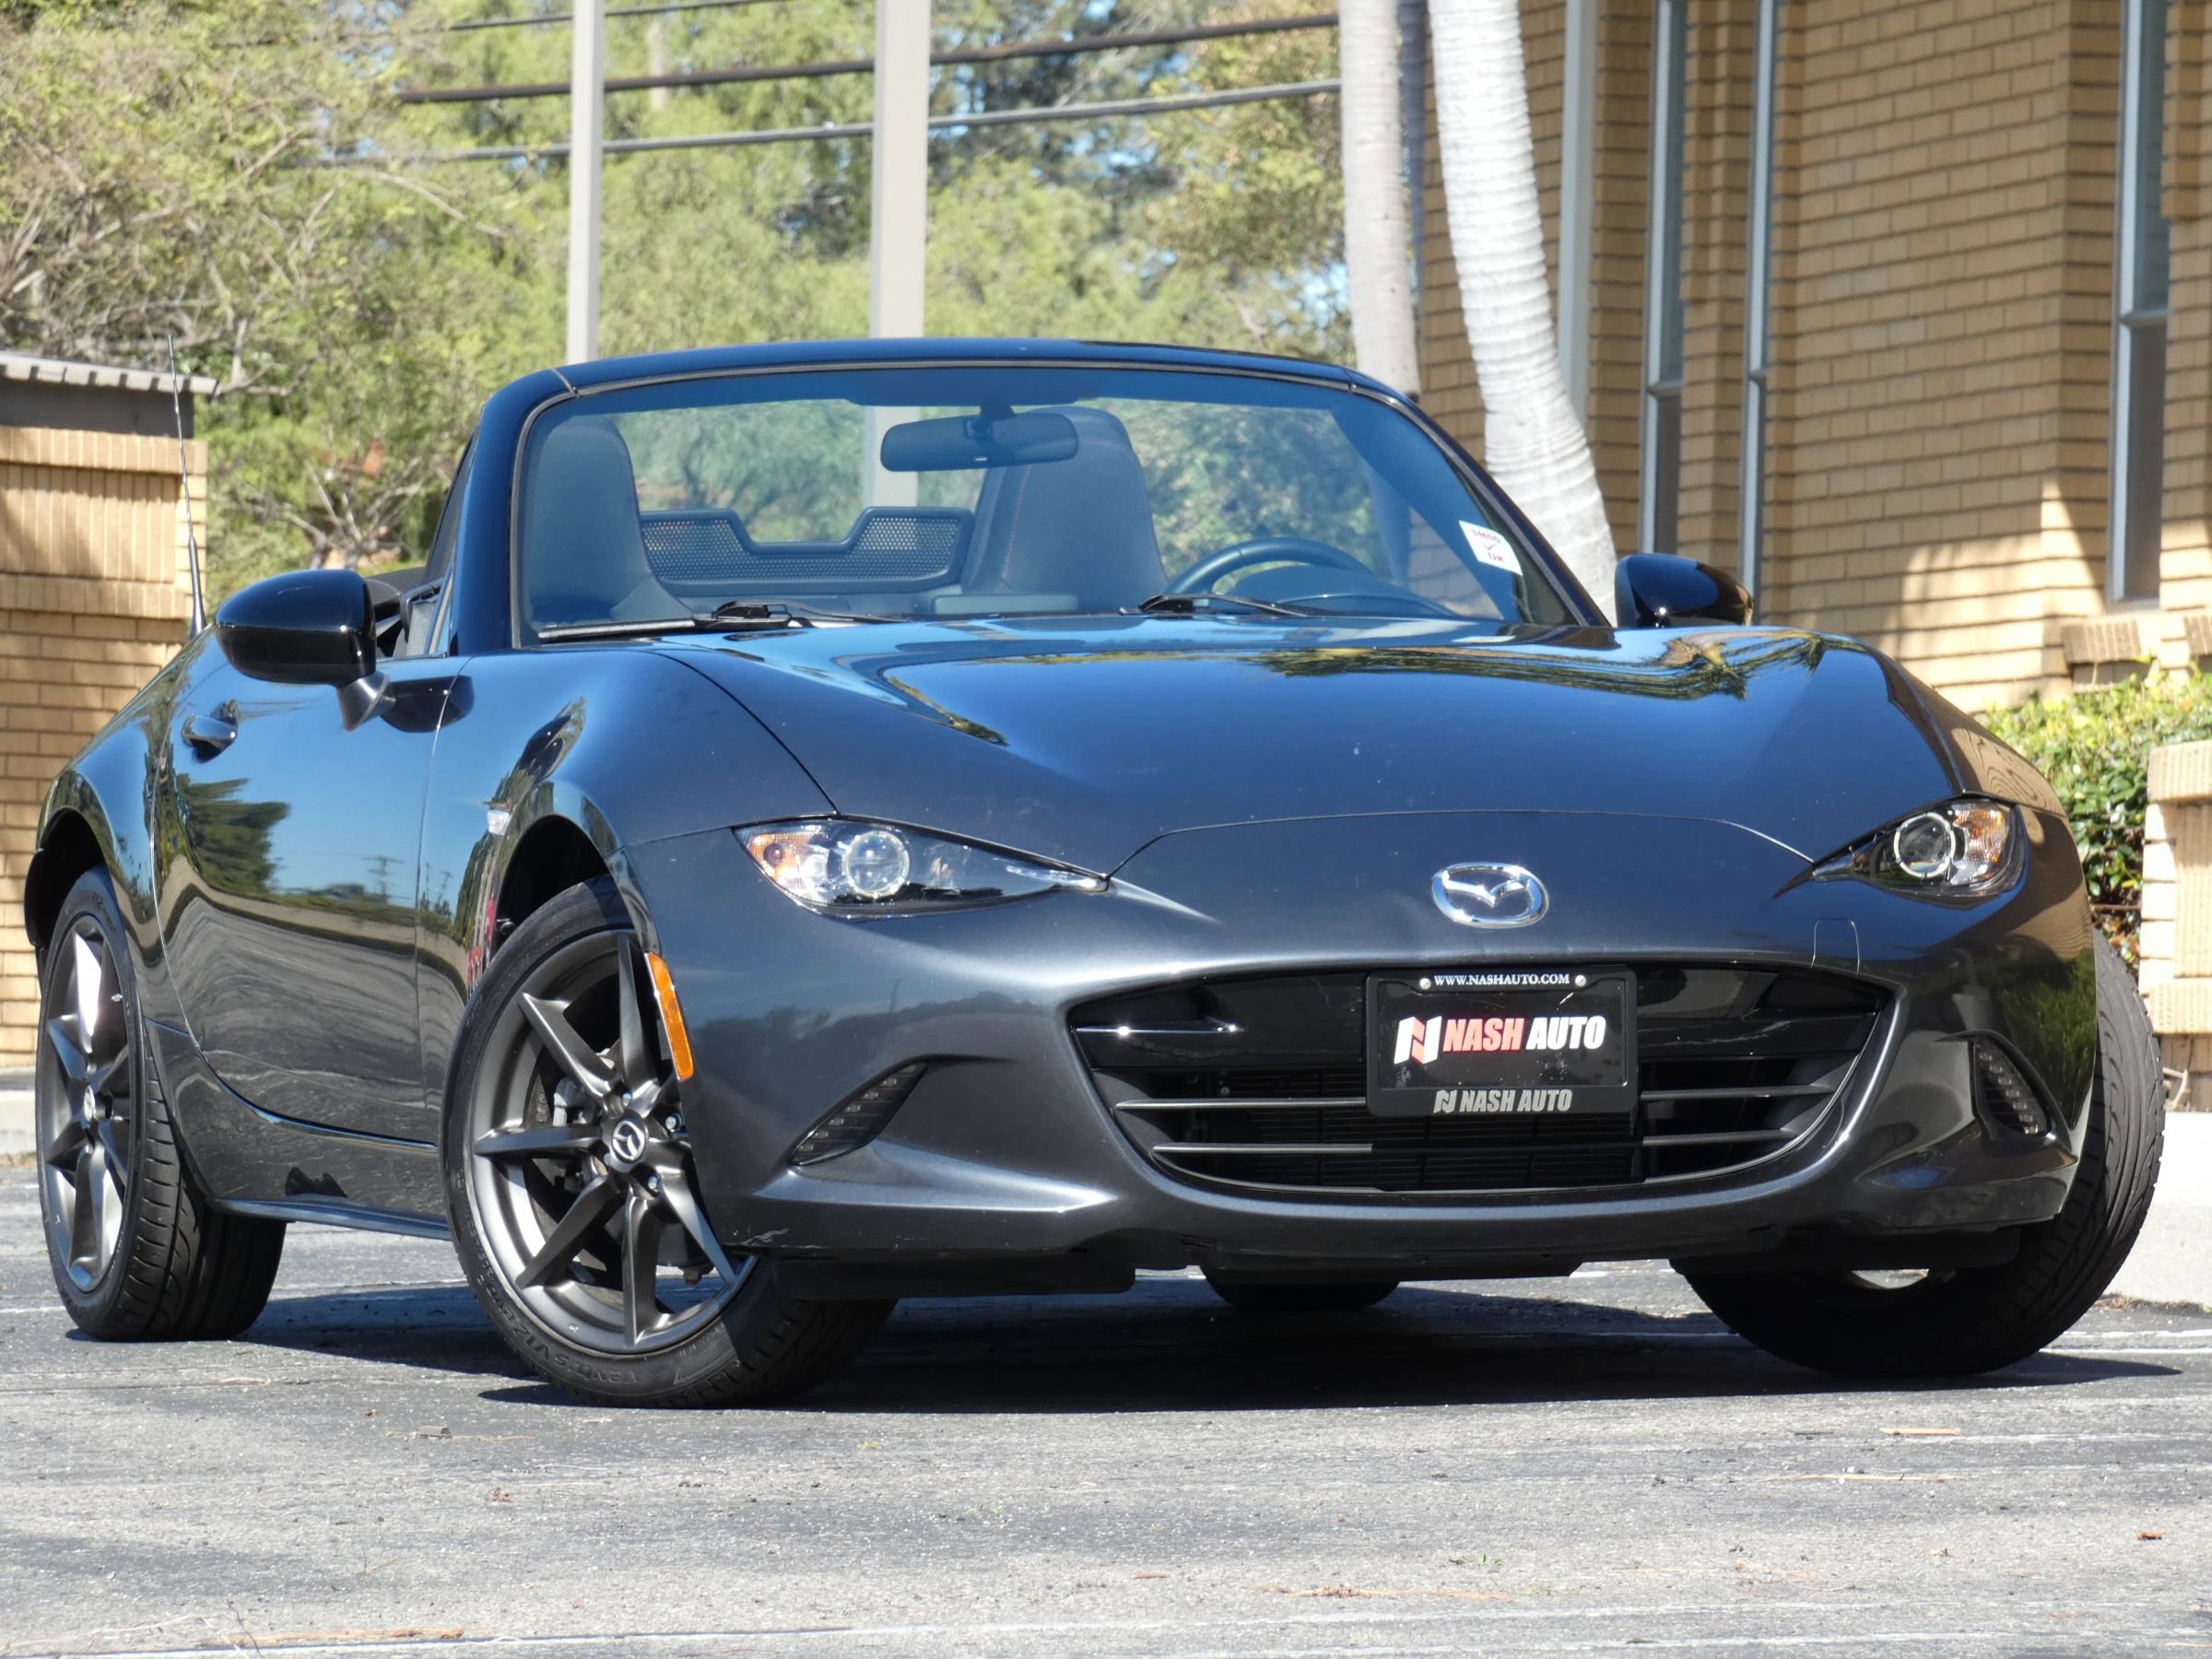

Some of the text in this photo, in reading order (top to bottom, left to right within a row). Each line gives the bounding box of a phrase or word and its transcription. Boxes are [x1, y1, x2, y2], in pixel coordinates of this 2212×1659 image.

[1434, 973, 1570, 986] WWW.NASHAUTO.COM
[1443, 1018, 1525, 1053] NASH
[1526, 1016, 1606, 1051] AUTO
[1459, 1089, 1516, 1112] NASH
[1517, 1089, 1572, 1112] AUTO
